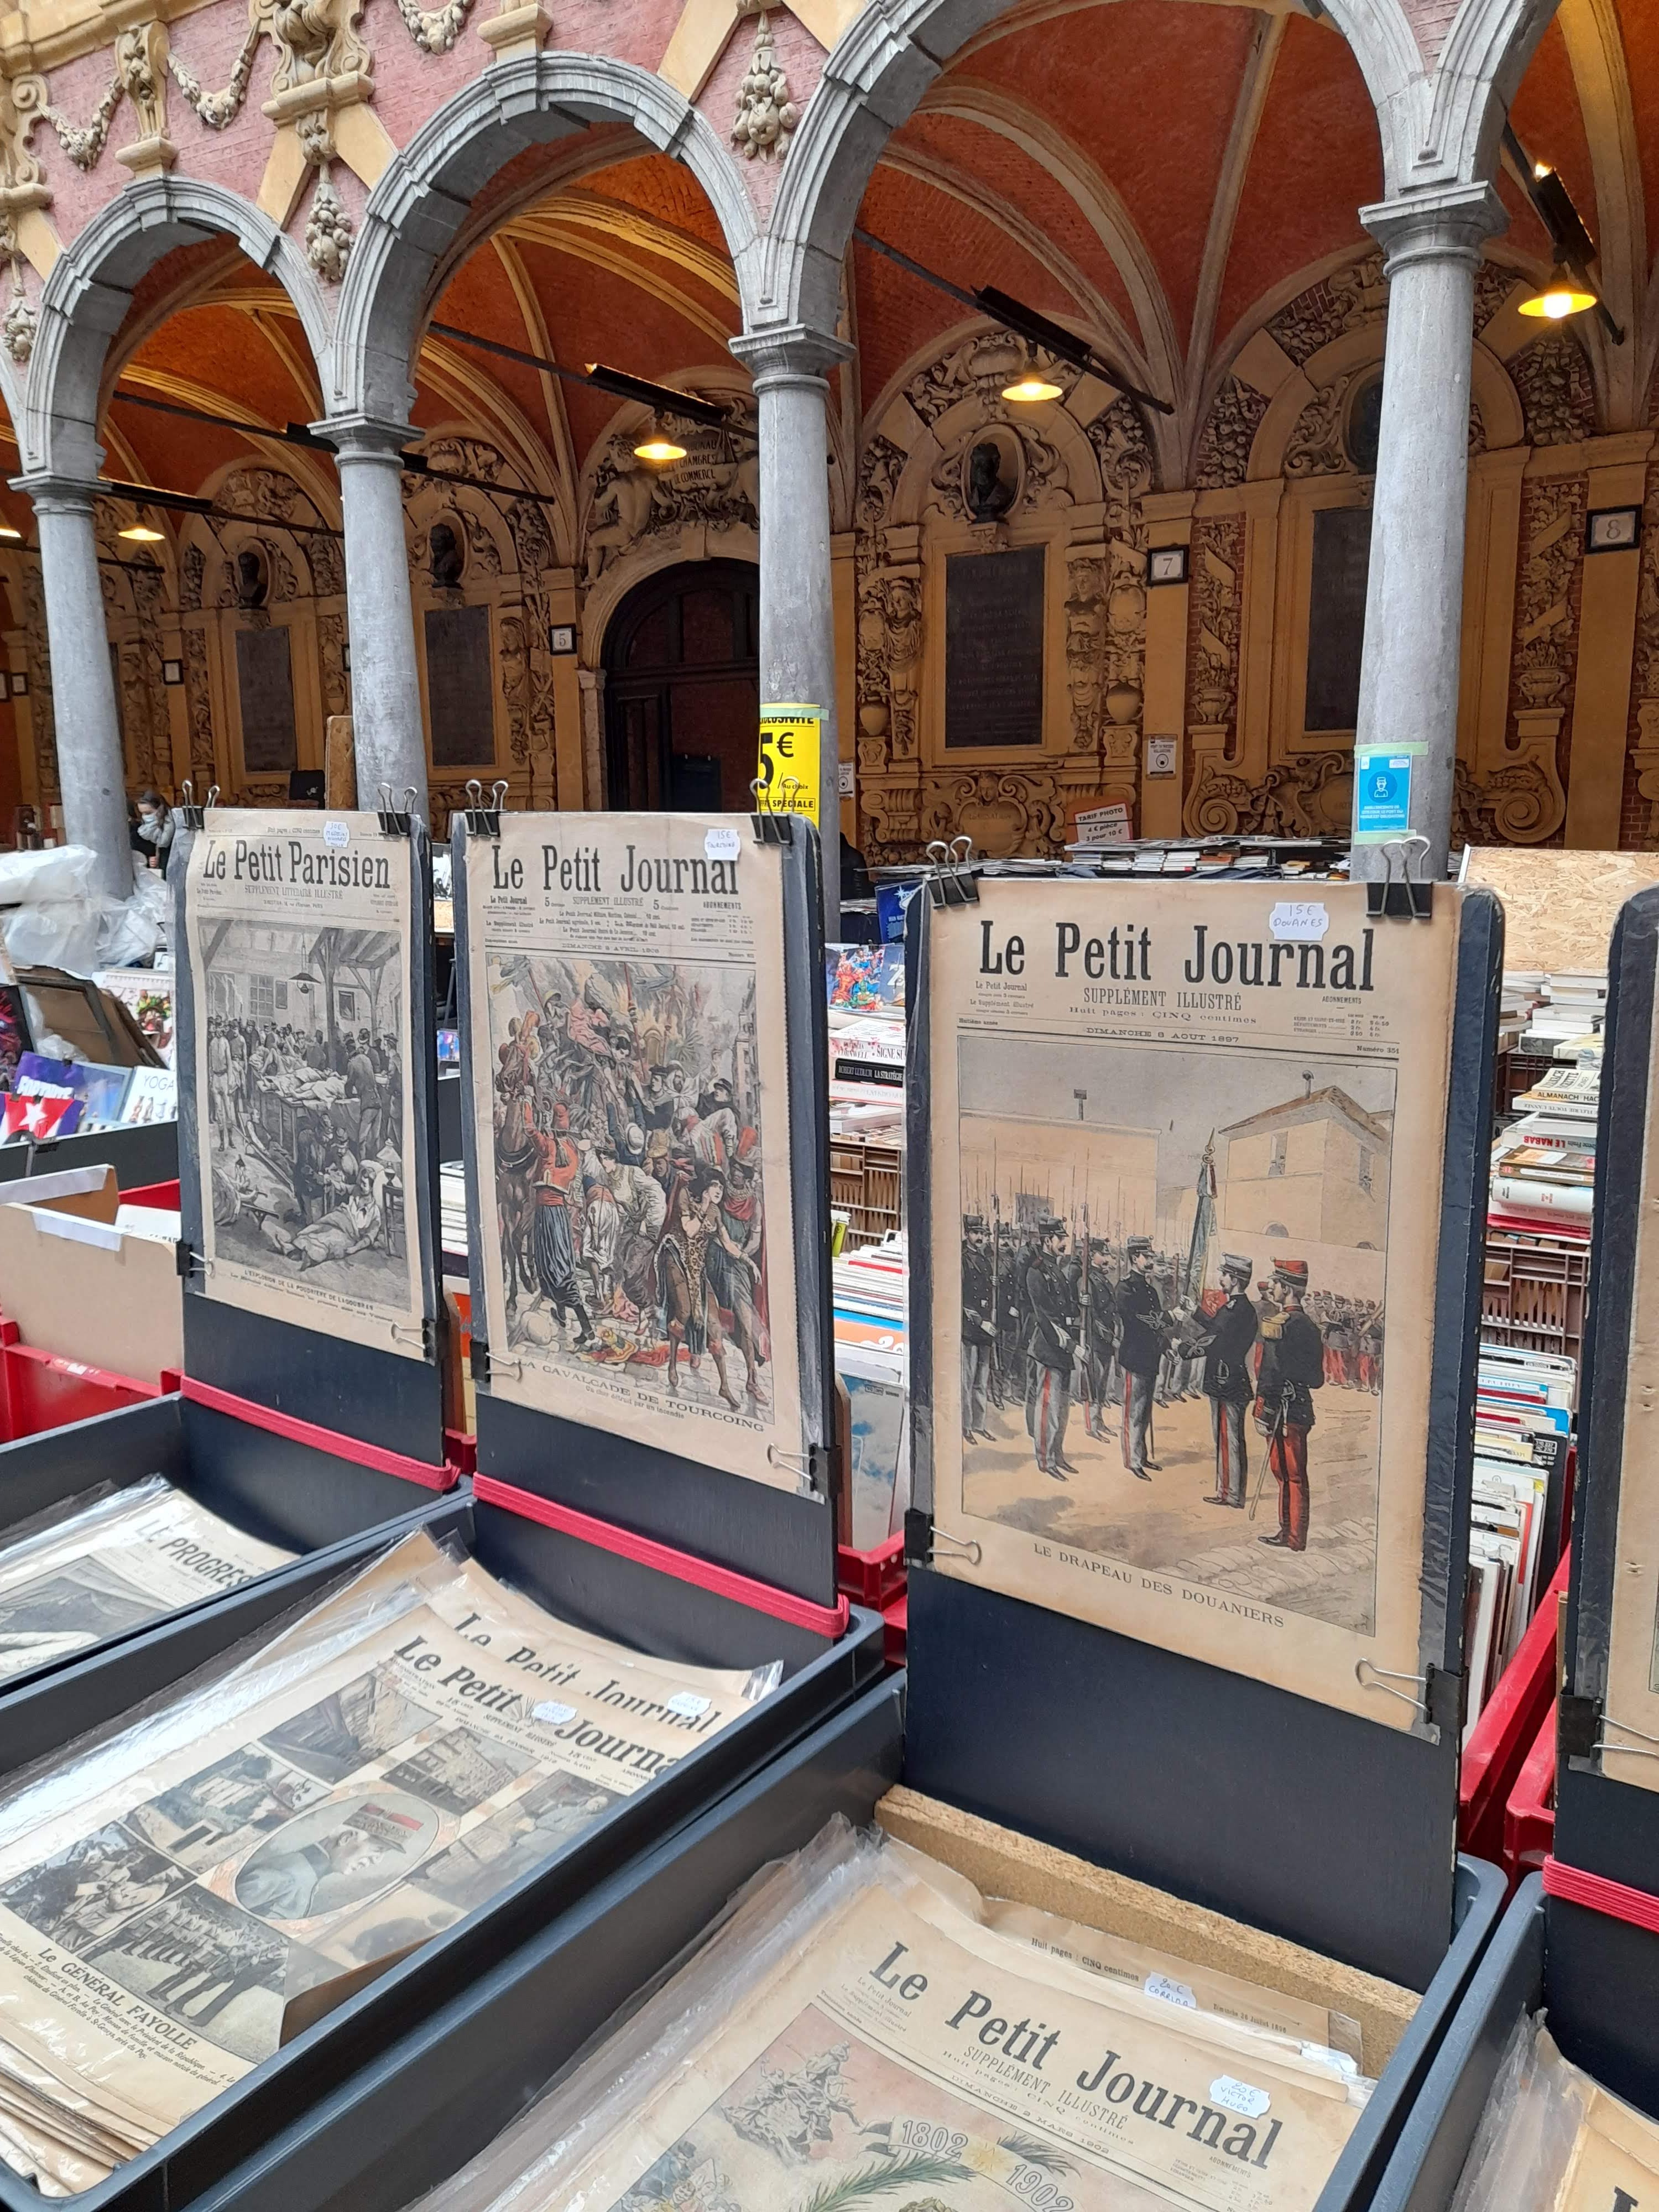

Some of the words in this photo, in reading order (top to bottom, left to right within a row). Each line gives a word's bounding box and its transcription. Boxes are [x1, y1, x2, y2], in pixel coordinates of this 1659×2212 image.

[1606, 519, 1621, 539] 8
[1163, 557, 1173, 575] 7
[559, 633, 566, 647] 5
[1078, 813, 1097, 822] TARIF
[1099, 808, 1123, 817] PHOTO
[203, 840, 226, 880] Le
[234, 839, 283, 881] Petit
[288, 841, 390, 889] Parisien
[492, 845, 523, 889] Le
[541, 845, 601, 892] Petit
[620, 845, 738, 895] Journal
[545, 896, 550, 907] 5
[653, 899, 659, 910] 5
[1289, 904, 1316, 916] 15€
[1273, 917, 1323, 927] DOUANES
[979, 920, 1025, 975] Le
[1055, 922, 1151, 980] Petit
[1185, 925, 1374, 991] Journal
[975, 980, 983, 989] Le
[985, 981, 1001, 989] Petit
[1003, 982, 1027, 991] Journal
[1083, 987, 1166, 1008] SUPPLÉMENT
[1177, 992, 1241, 1011] ILLUSTRÉ
[1322, 996, 1361, 1004] ABONNEMENTS
[1070, 1006, 1096, 1015] Huit
[1102, 1010, 1136, 1018] pages
[1152, 1011, 1192, 1021] CINQ
[1199, 1014, 1256, 1024] centimes
[1086, 1027, 1152, 1037] DIMANCHE
[877, 1046, 895, 1060] SIGNE
[144, 1074, 174, 1091] YOGA
[1537, 1091, 1579, 1100] ALMANACH
[1583, 1093, 1599, 1102] HAC
[1524, 1135, 1553, 1146] NABAB
[1554, 1140, 1566, 1148] LE
[518, 1358, 535, 1370] LA
[542, 1364, 631, 1397] CAVALCADE
[637, 1392, 659, 1405] DE
[665, 1399, 765, 1433] TOURCOING
[657, 1406, 685, 1420] incendie
[1034, 1543, 1051, 1557] LE
[1060, 1551, 1133, 1584] DRAPEAU
[1141, 1578, 1172, 1595] DES
[1182, 1589, 1284, 1628] DOUANIERS
[393, 1635, 441, 1672] Le
[437, 1665, 523, 1712] Petit
[554, 1718, 680, 1776] Journa
[1031, 1937, 1048, 1950] Huit
[1051, 1944, 1072, 1959] pages
[1082, 1957, 1102, 1970] CINQ
[1104, 1964, 1139, 1983] centimes
[38, 1948, 57, 1962] Le
[61, 1963, 125, 2006] GÉNÉRAL
[126, 2005, 197, 2050] FAYOLLE
[868, 1985, 885, 2000] Petit
[884, 1997, 912, 2017] Journal
[1149, 1985, 1188, 2006] CORRIDA
[869, 1941, 928, 2001] Le
[944, 1989, 1061, 2070] Petit
[1076, 2049, 1283, 2171] Journal
[964, 2046, 1051, 2094] SUPPLÉMENT
[1057, 2089, 1129, 2130] ILLUSTRÉ
[1221, 2086, 1255, 2105] VICTOR
[1027, 2092, 1066, 2115] CINQ
[1221, 2096, 1248, 2111] HUGO
[951, 2075, 1019, 2111] DIMANCHE
[1036, 2116, 1074, 2138] MARS
[1079, 2138, 1110, 2154] 1902
[902, 2120, 968, 2159] 1802
[1005, 2163, 1074, 2212] 1902
[1209, 2156, 1252, 2178] ABONNEMENTS
